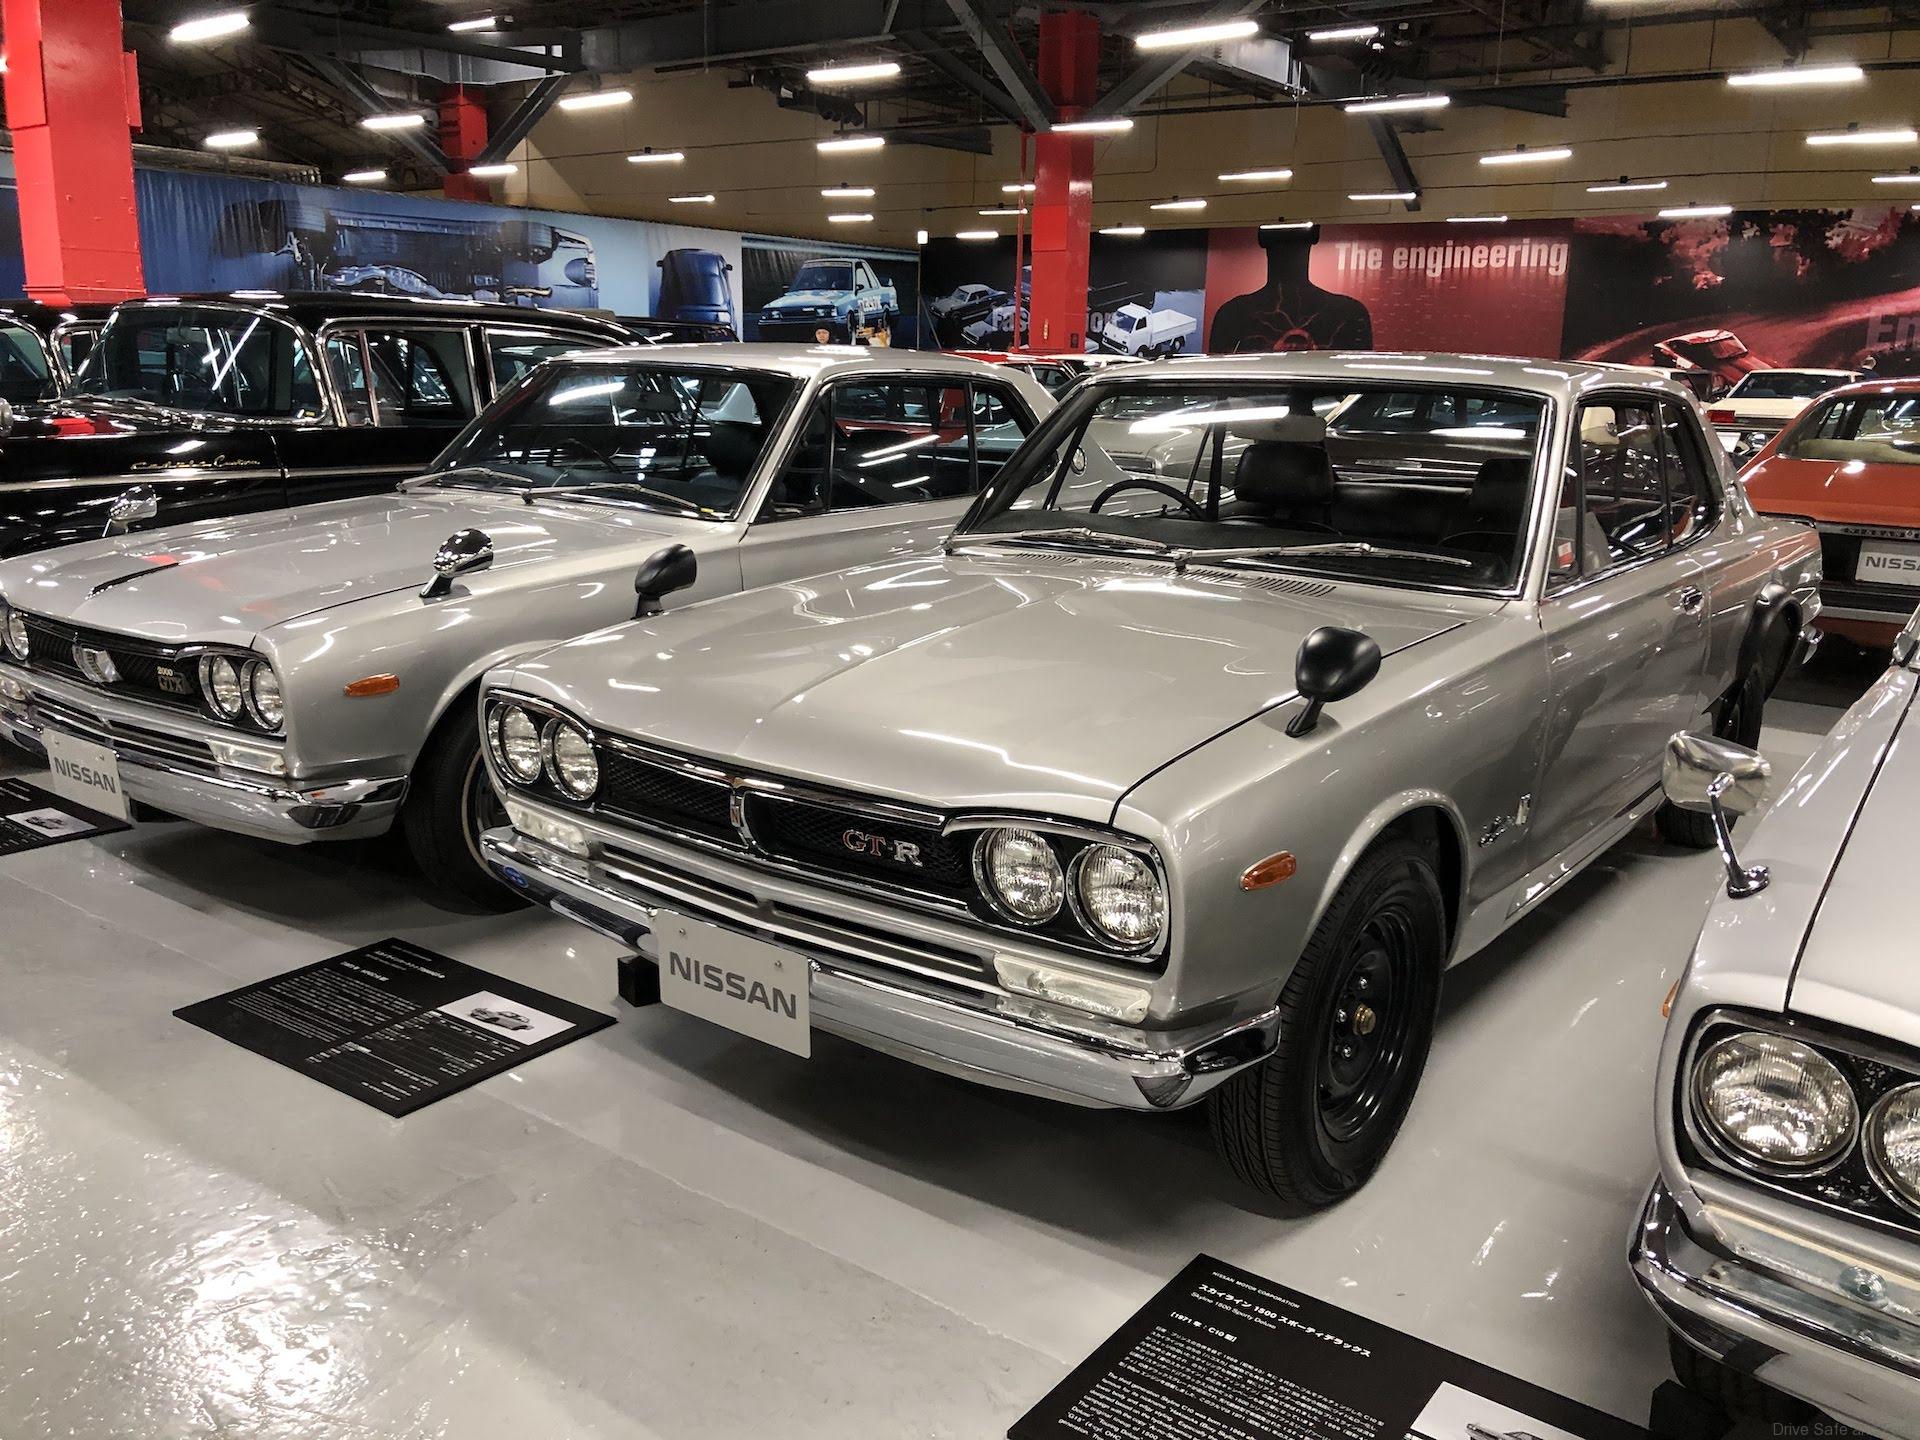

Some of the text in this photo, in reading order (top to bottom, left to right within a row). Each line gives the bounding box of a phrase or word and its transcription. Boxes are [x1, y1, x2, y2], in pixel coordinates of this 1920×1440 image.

[1335, 238, 1569, 277] The engineering
[1865, 555, 1920, 571] NISS
[53, 756, 117, 794] NISSAN
[669, 951, 798, 1020] NISSAN
[1212, 1271, 1300, 1309] NISSAN MOTOR CORPORATION
[1215, 1301, 1232, 1312] 1500
[1254, 1305, 1277, 1319] 1500
